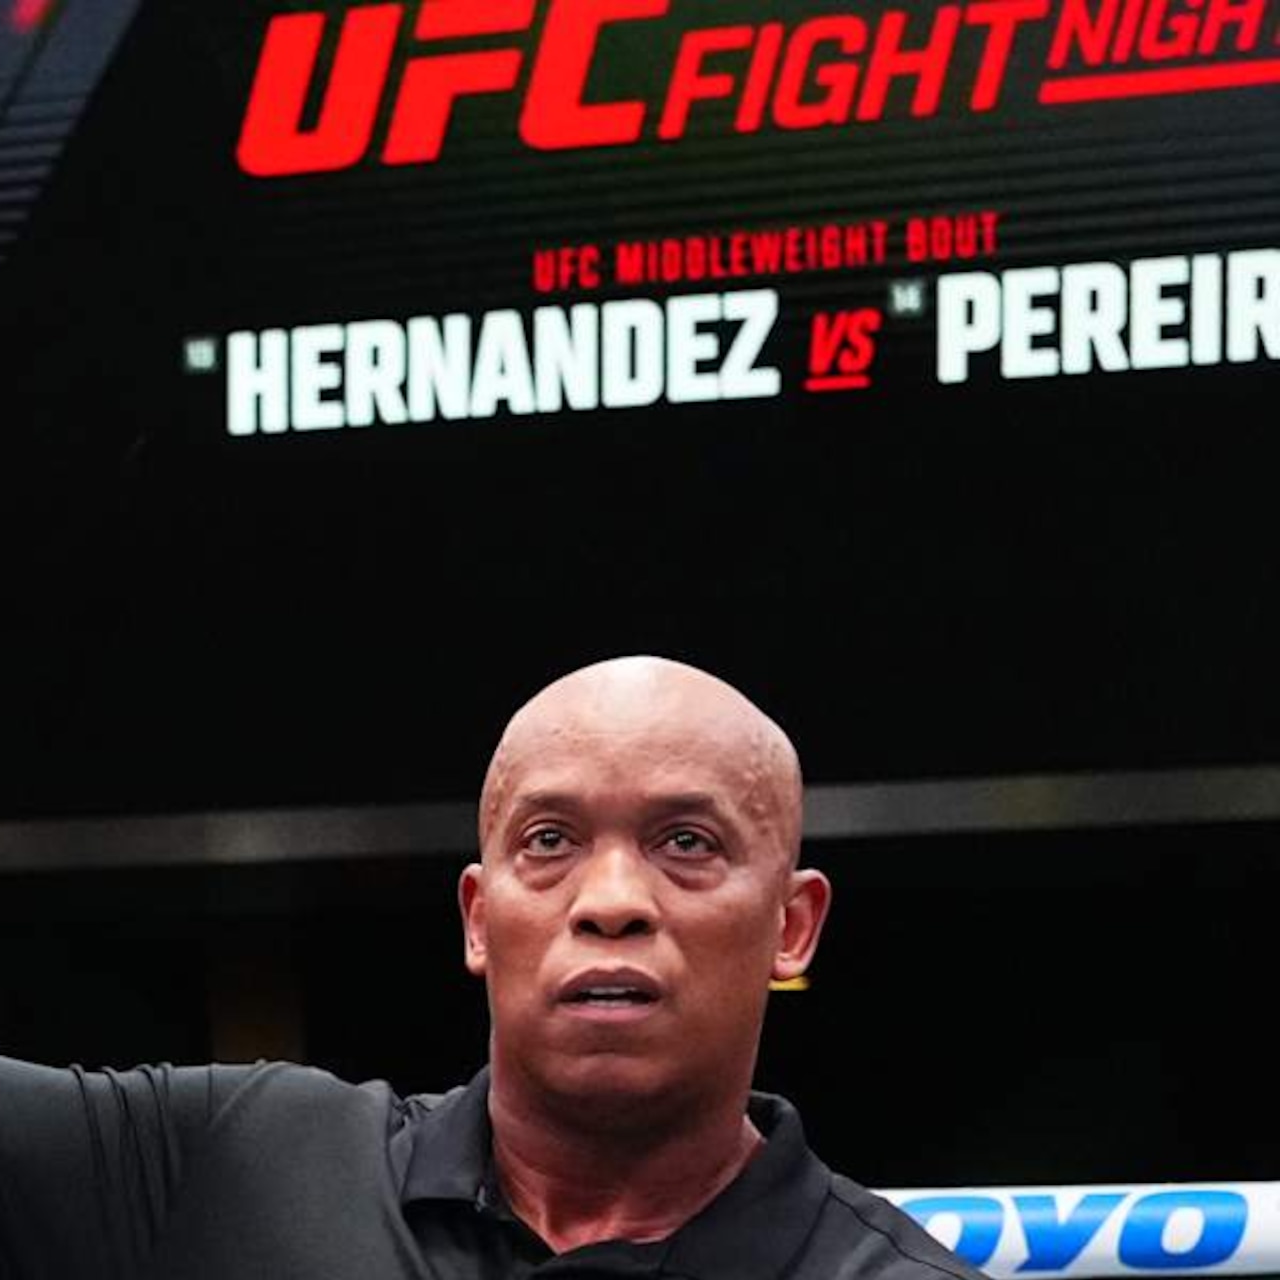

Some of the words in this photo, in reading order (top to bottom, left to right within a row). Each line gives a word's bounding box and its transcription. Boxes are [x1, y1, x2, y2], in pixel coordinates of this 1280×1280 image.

[235, 0, 672, 177] UFC
[656, 0, 1049, 141] FIGHT
[1046, 0, 1280, 70] NIGH
[533, 244, 600, 292] UFC
[615, 220, 889, 284] MIDDLEWEIGHT
[905, 211, 999, 262] BOUT
[226, 289, 782, 436] HERNANDEZ
[808, 307, 882, 375] VS
